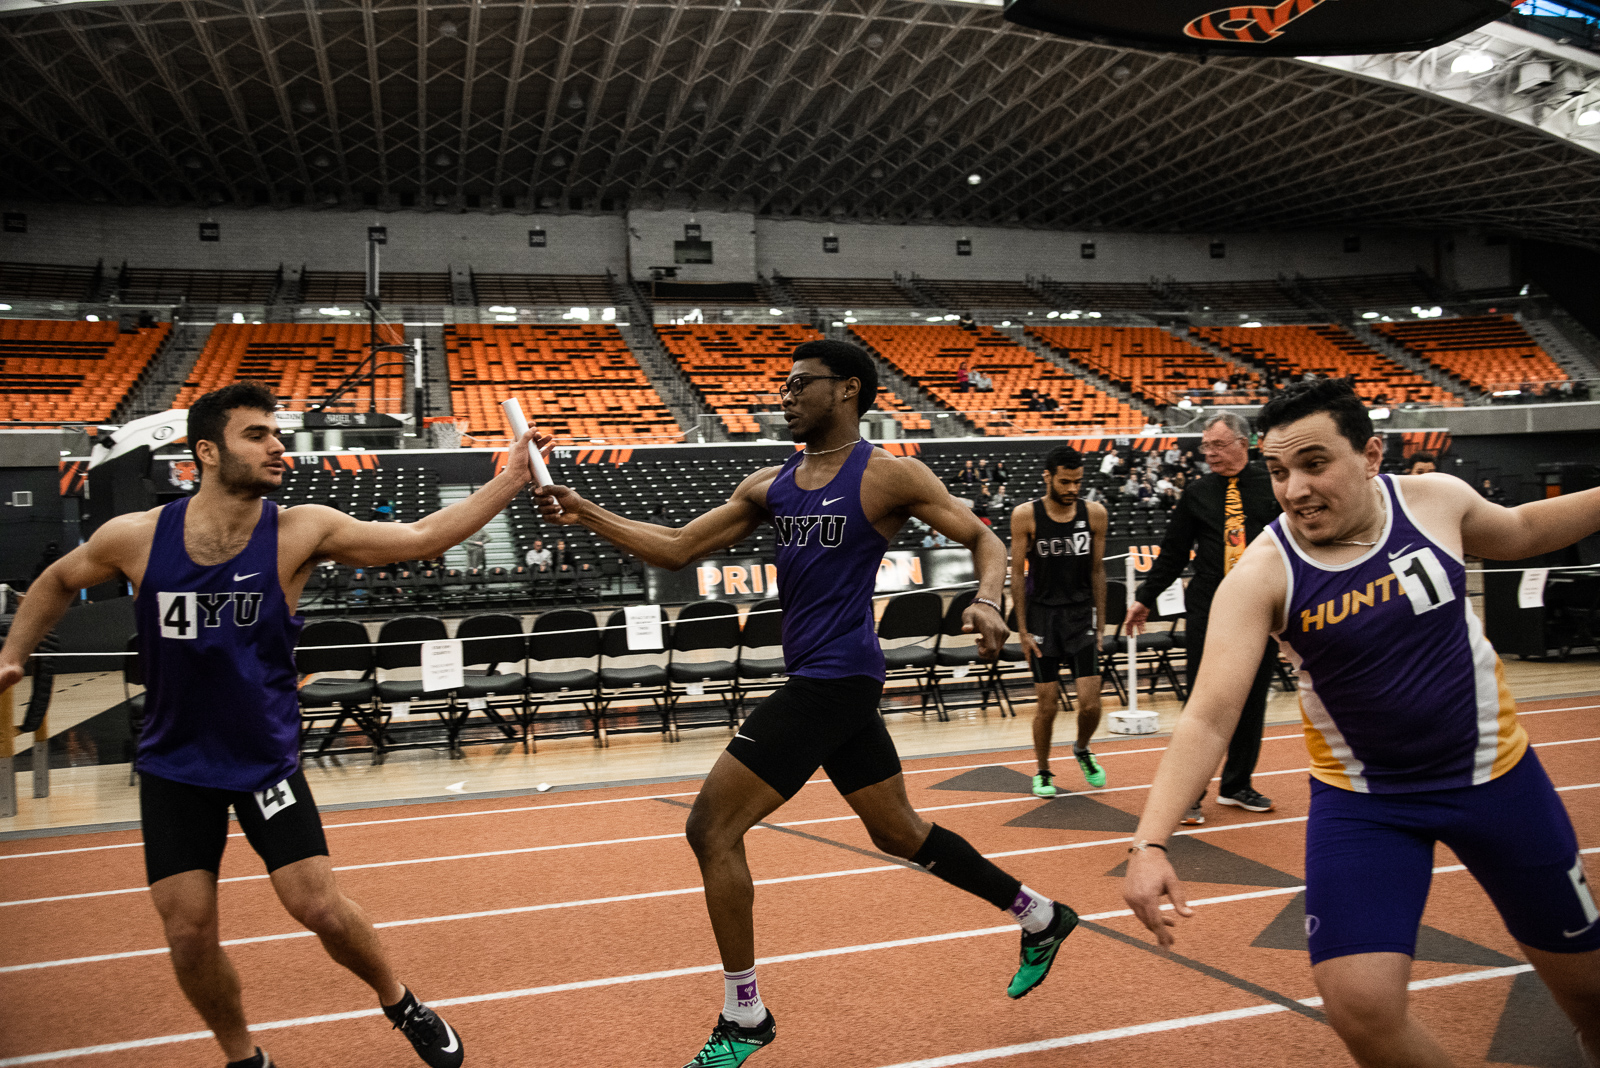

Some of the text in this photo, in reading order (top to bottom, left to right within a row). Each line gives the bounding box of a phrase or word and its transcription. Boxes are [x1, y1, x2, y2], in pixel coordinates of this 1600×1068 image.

[299, 456, 319, 464] 113
[554, 450, 572, 458] 114
[775, 515, 847, 548] NYU
[1036, 537, 1077, 557] CCN
[1076, 534, 1088, 553] 2
[696, 557, 924, 596] PRINON
[1403, 556, 1441, 606] 1
[197, 592, 263, 628] YU
[1301, 573, 1407, 632] HUNT
[163, 595, 191, 636] 4
[262, 786, 287, 808] 4
[1018, 900, 1038, 920] NYU
[738, 996, 758, 1007] NYU
